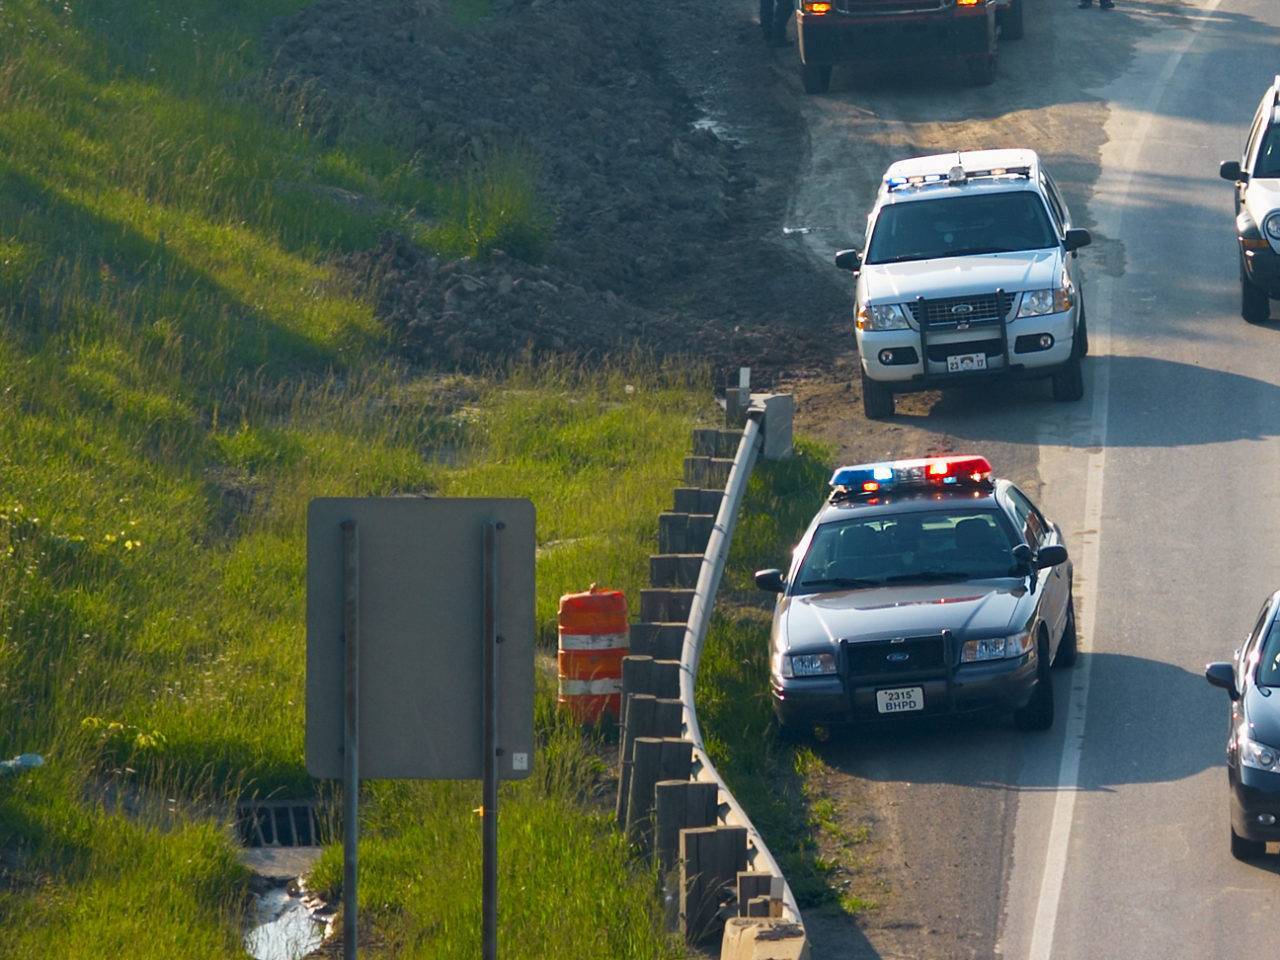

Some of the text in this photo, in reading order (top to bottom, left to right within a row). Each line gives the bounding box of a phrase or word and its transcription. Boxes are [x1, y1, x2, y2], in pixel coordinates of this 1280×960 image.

[950, 359, 984, 370] 23 17
[888, 691, 912, 701] 2315
[885, 700, 917, 711] BHPD
